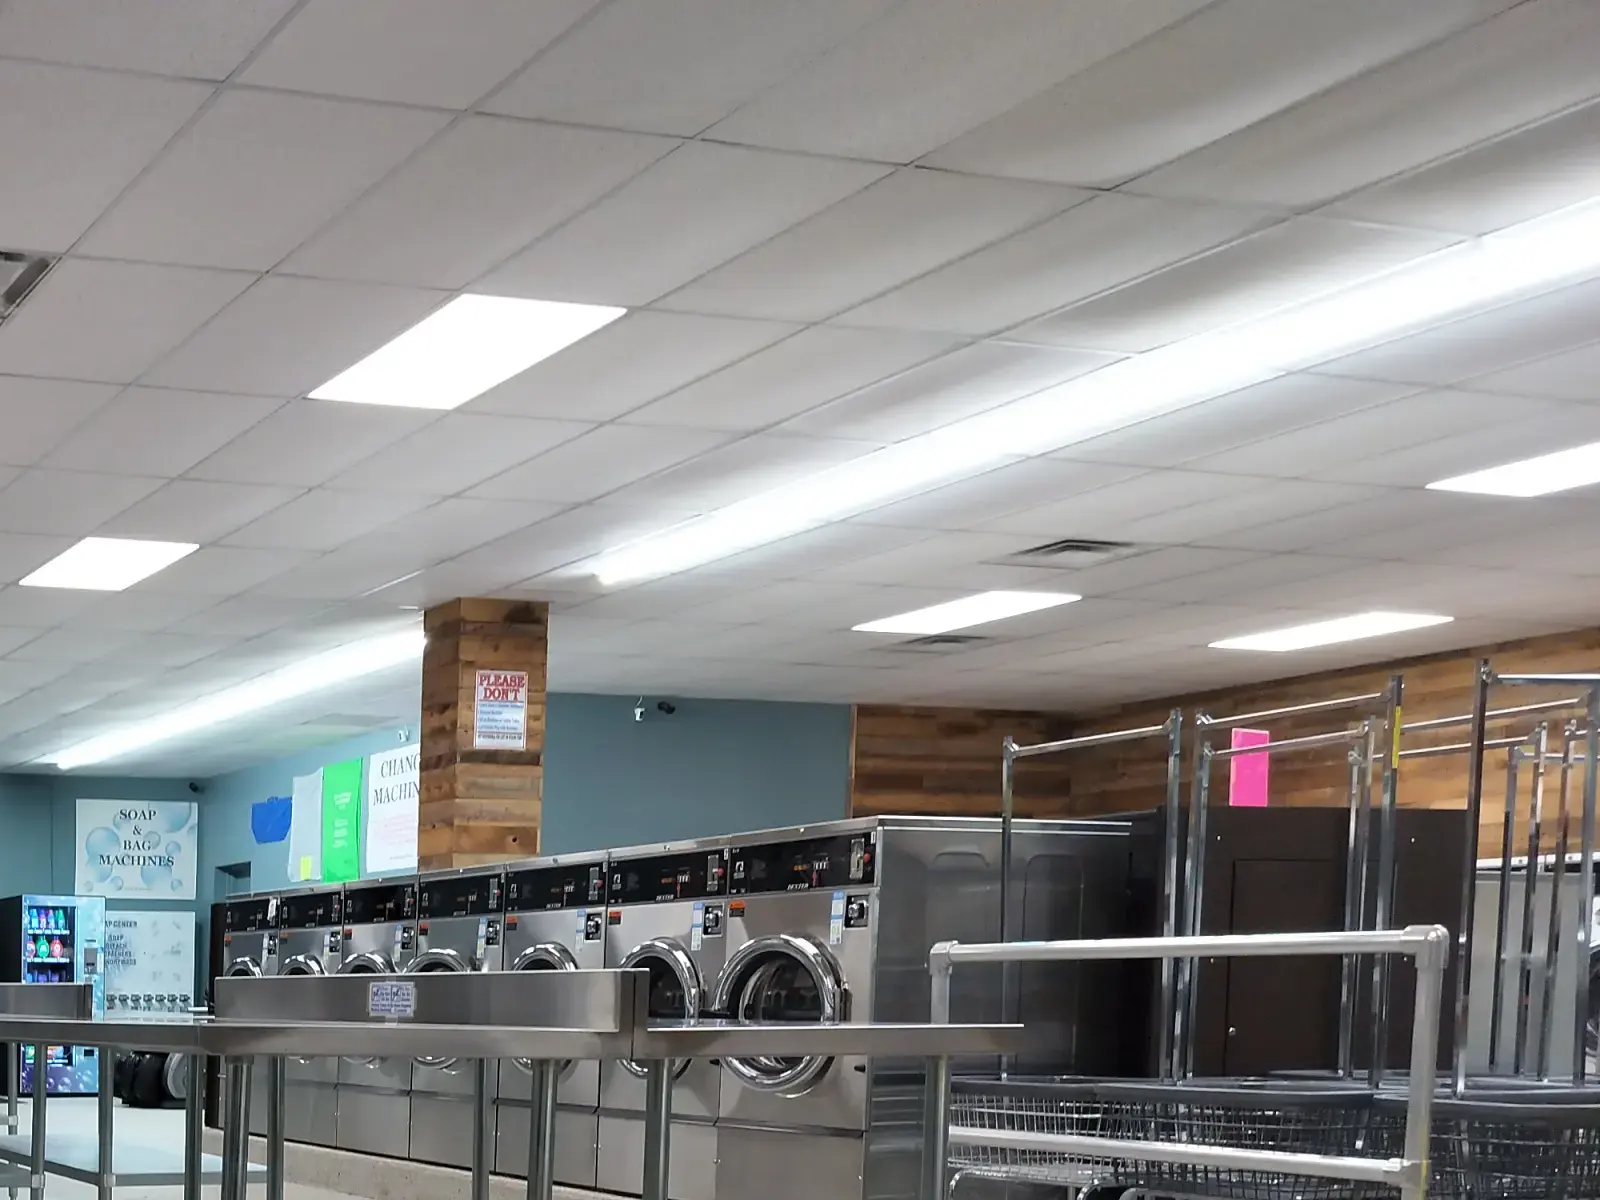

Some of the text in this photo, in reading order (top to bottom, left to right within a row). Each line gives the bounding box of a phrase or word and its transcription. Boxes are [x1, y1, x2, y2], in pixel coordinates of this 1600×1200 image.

[479, 674, 526, 688] PLEASE
[483, 687, 521, 701] DON'T
[119, 808, 157, 820] SOAP
[132, 825, 142, 836] &
[122, 840, 152, 851] BAG
[99, 855, 175, 867] MACHINES
